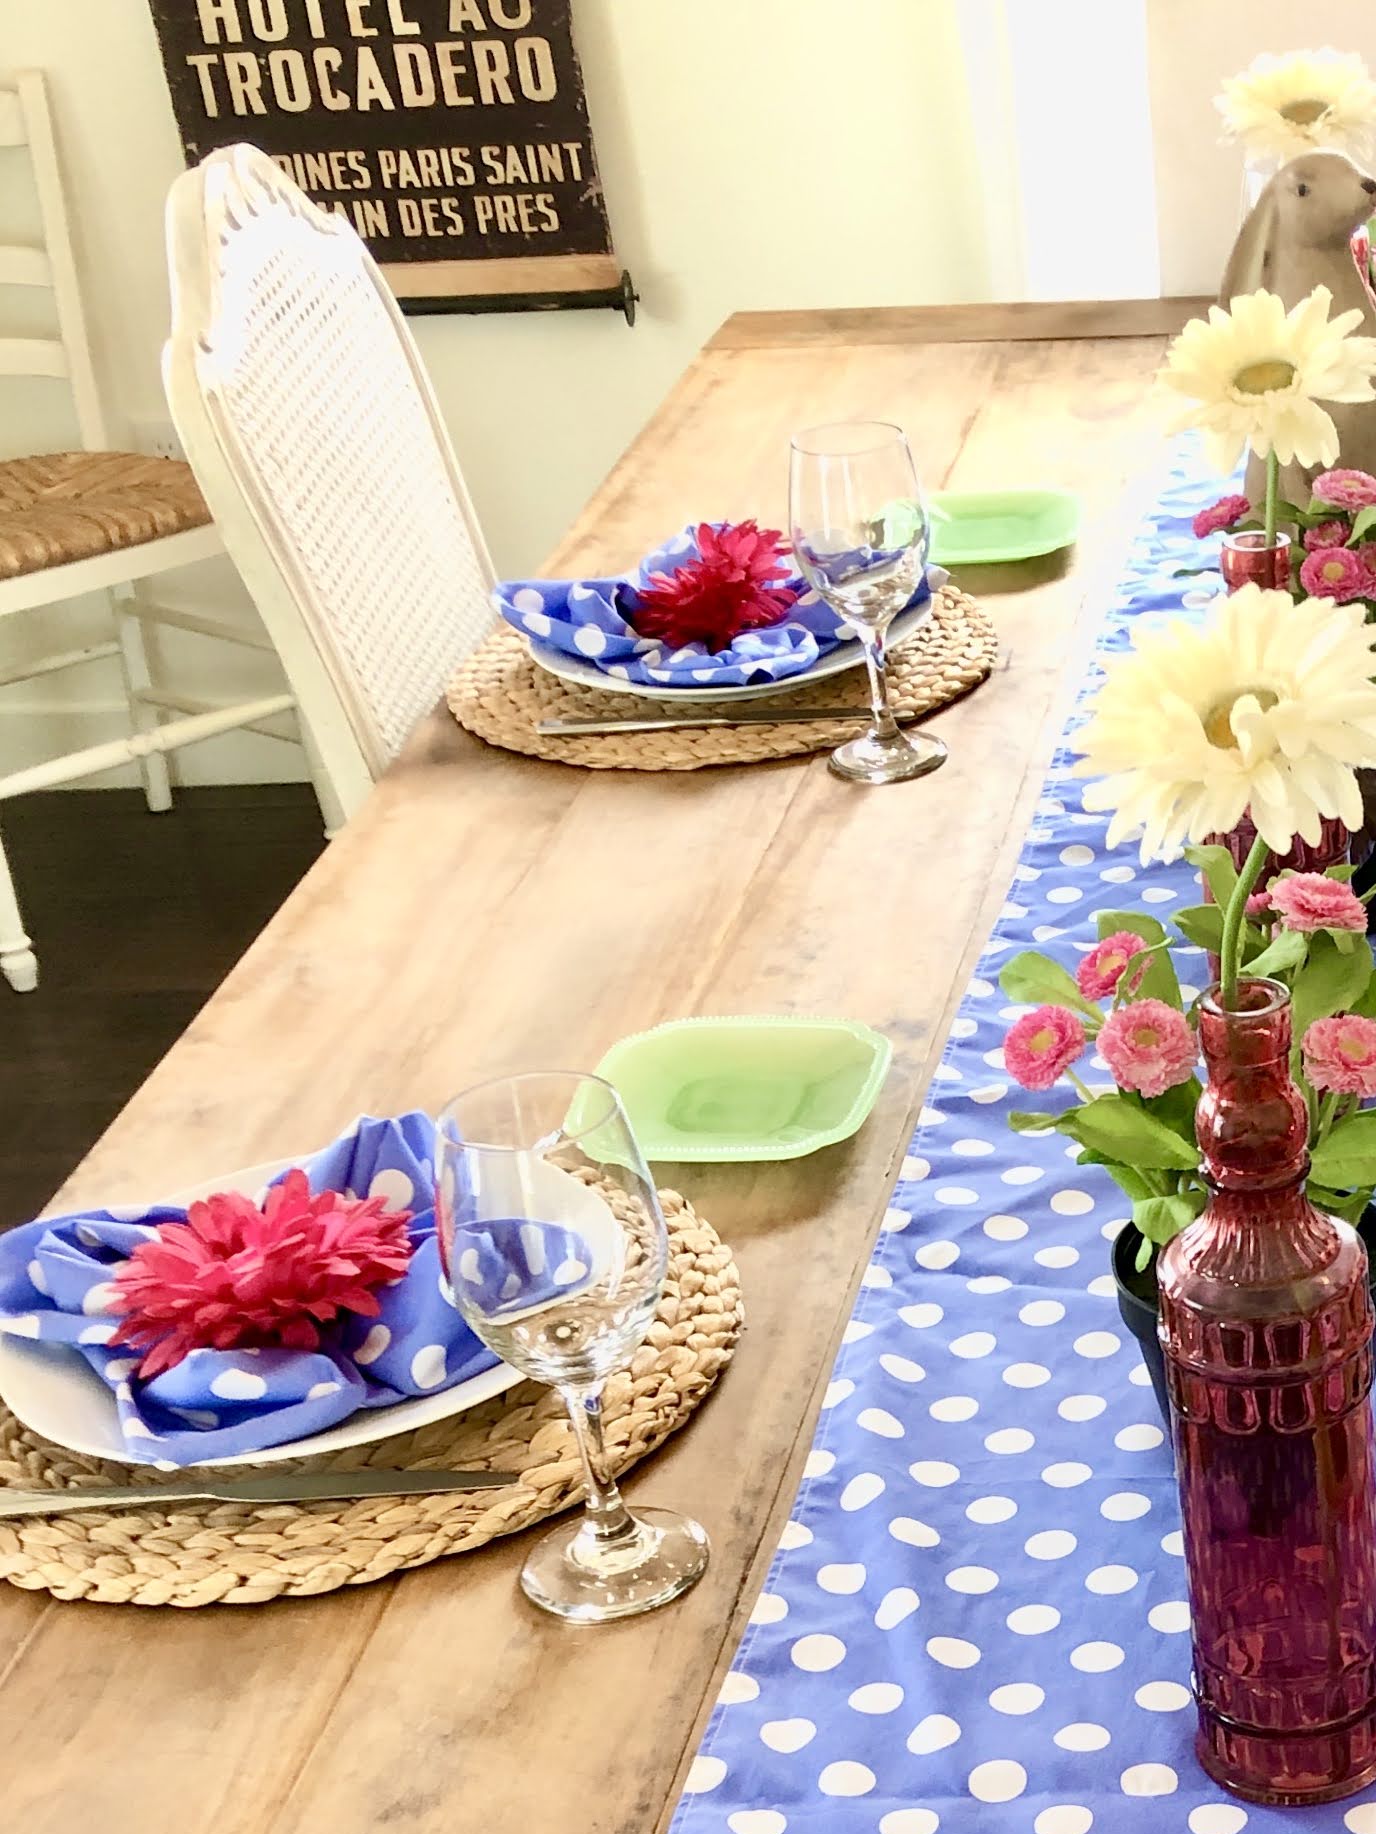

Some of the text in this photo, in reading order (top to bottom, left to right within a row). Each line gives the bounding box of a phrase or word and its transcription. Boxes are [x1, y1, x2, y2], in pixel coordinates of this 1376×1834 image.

[198, 0, 421, 45] HOTEL
[186, 37, 558, 117] TROCADERO
[377, 147, 476, 189] PARIS
[480, 142, 583, 185] SAINT
[398, 197, 465, 238] DES
[474, 193, 560, 235] PRES
